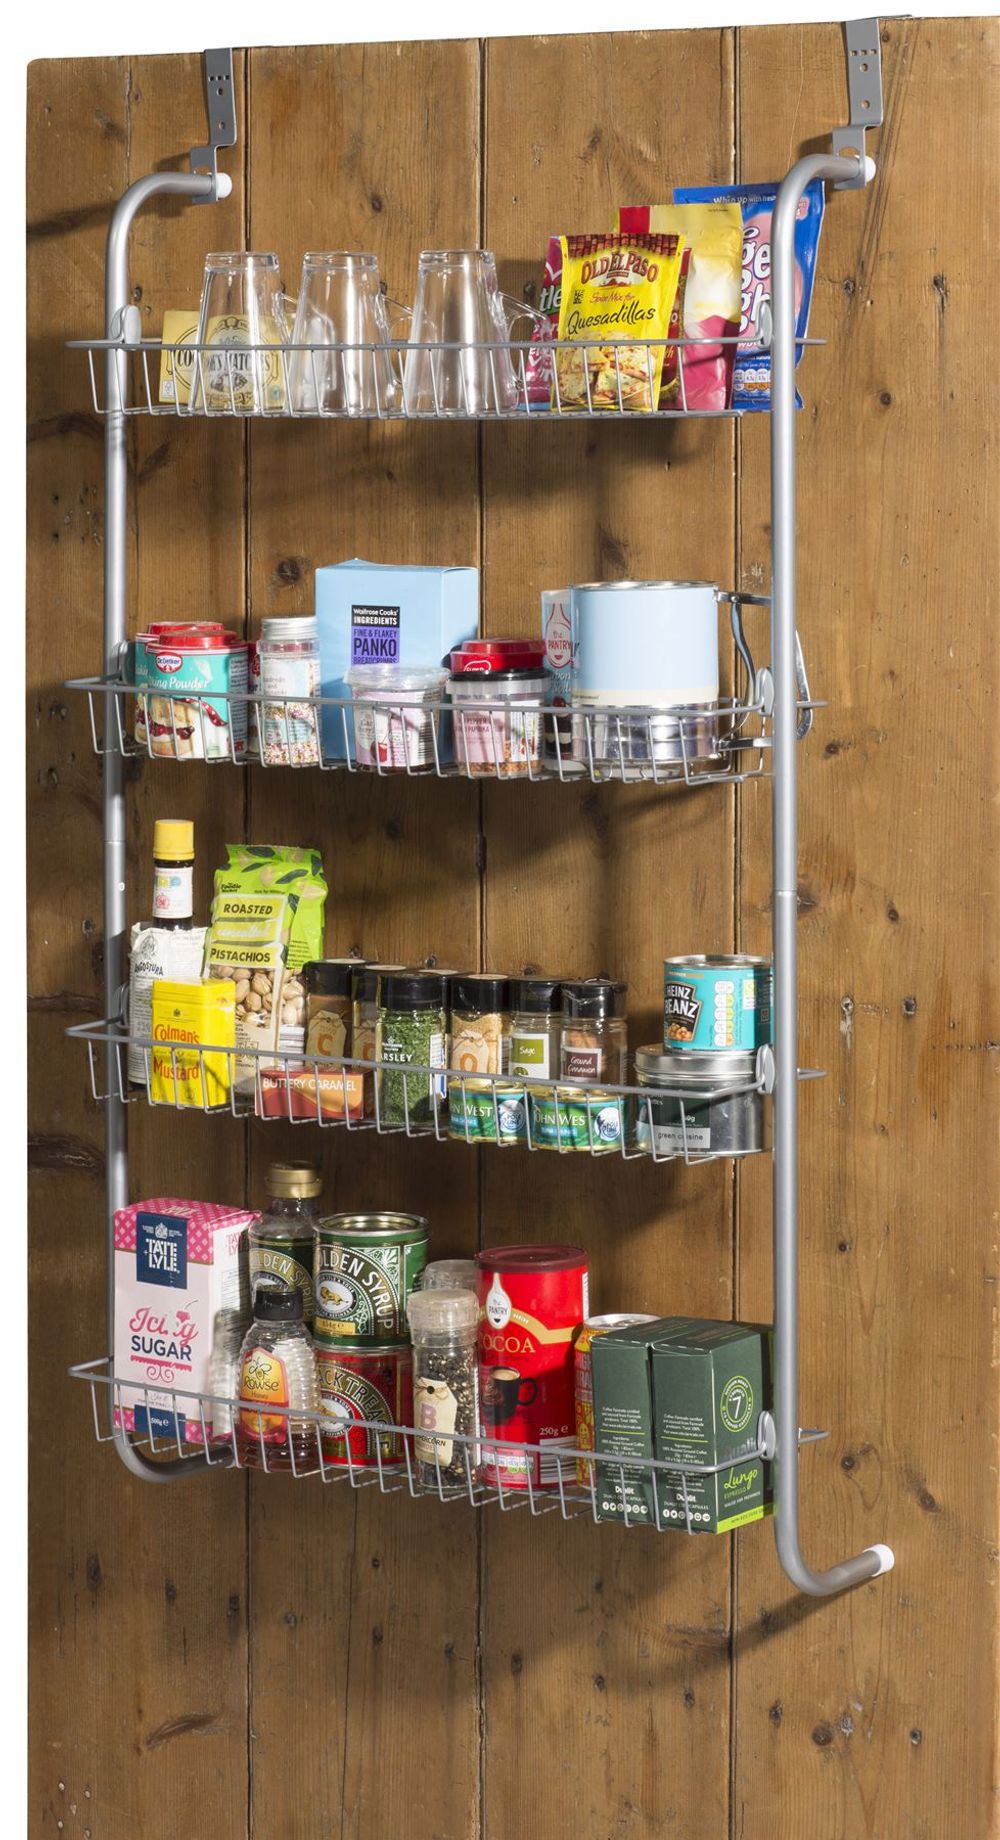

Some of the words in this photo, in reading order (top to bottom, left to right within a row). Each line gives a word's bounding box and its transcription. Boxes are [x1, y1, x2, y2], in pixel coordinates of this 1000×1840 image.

[581, 261, 608, 285] OLD
[609, 252, 625, 272] EL
[567, 300, 656, 335] Quesadillas
[354, 616, 397, 625] INGREDIENTS
[354, 629, 367, 637] FINE
[368, 629, 373, 637] &
[374, 629, 397, 638] FLAKEY
[353, 638, 397, 656] PANKO
[169, 676, 208, 689] Powder
[223, 903, 273, 915] ROASTED
[210, 948, 271, 963] PISTACHIOS
[666, 985, 691, 1000] HEINZ
[664, 998, 698, 1019] BEANZ
[154, 1023, 200, 1045] Colman's
[382, 1052, 413, 1062] RSLEY
[519, 1046, 536, 1057] Sage
[153, 1056, 201, 1082] Mustard
[263, 1077, 306, 1089] BUTTERY
[308, 1079, 357, 1091] CARAMEL
[657, 1132, 676, 1140] green
[145, 1238, 178, 1258] TATE
[148, 1253, 181, 1273] LYLE
[362, 1271, 394, 1329] SYRUP
[131, 1334, 193, 1361] SUGAR
[243, 1375, 280, 1392] Rowse
[732, 1395, 742, 1419] 7
[421, 1403, 437, 1430] B
[539, 1427, 559, 1436] 250g
[723, 1467, 758, 1490] Lungo
